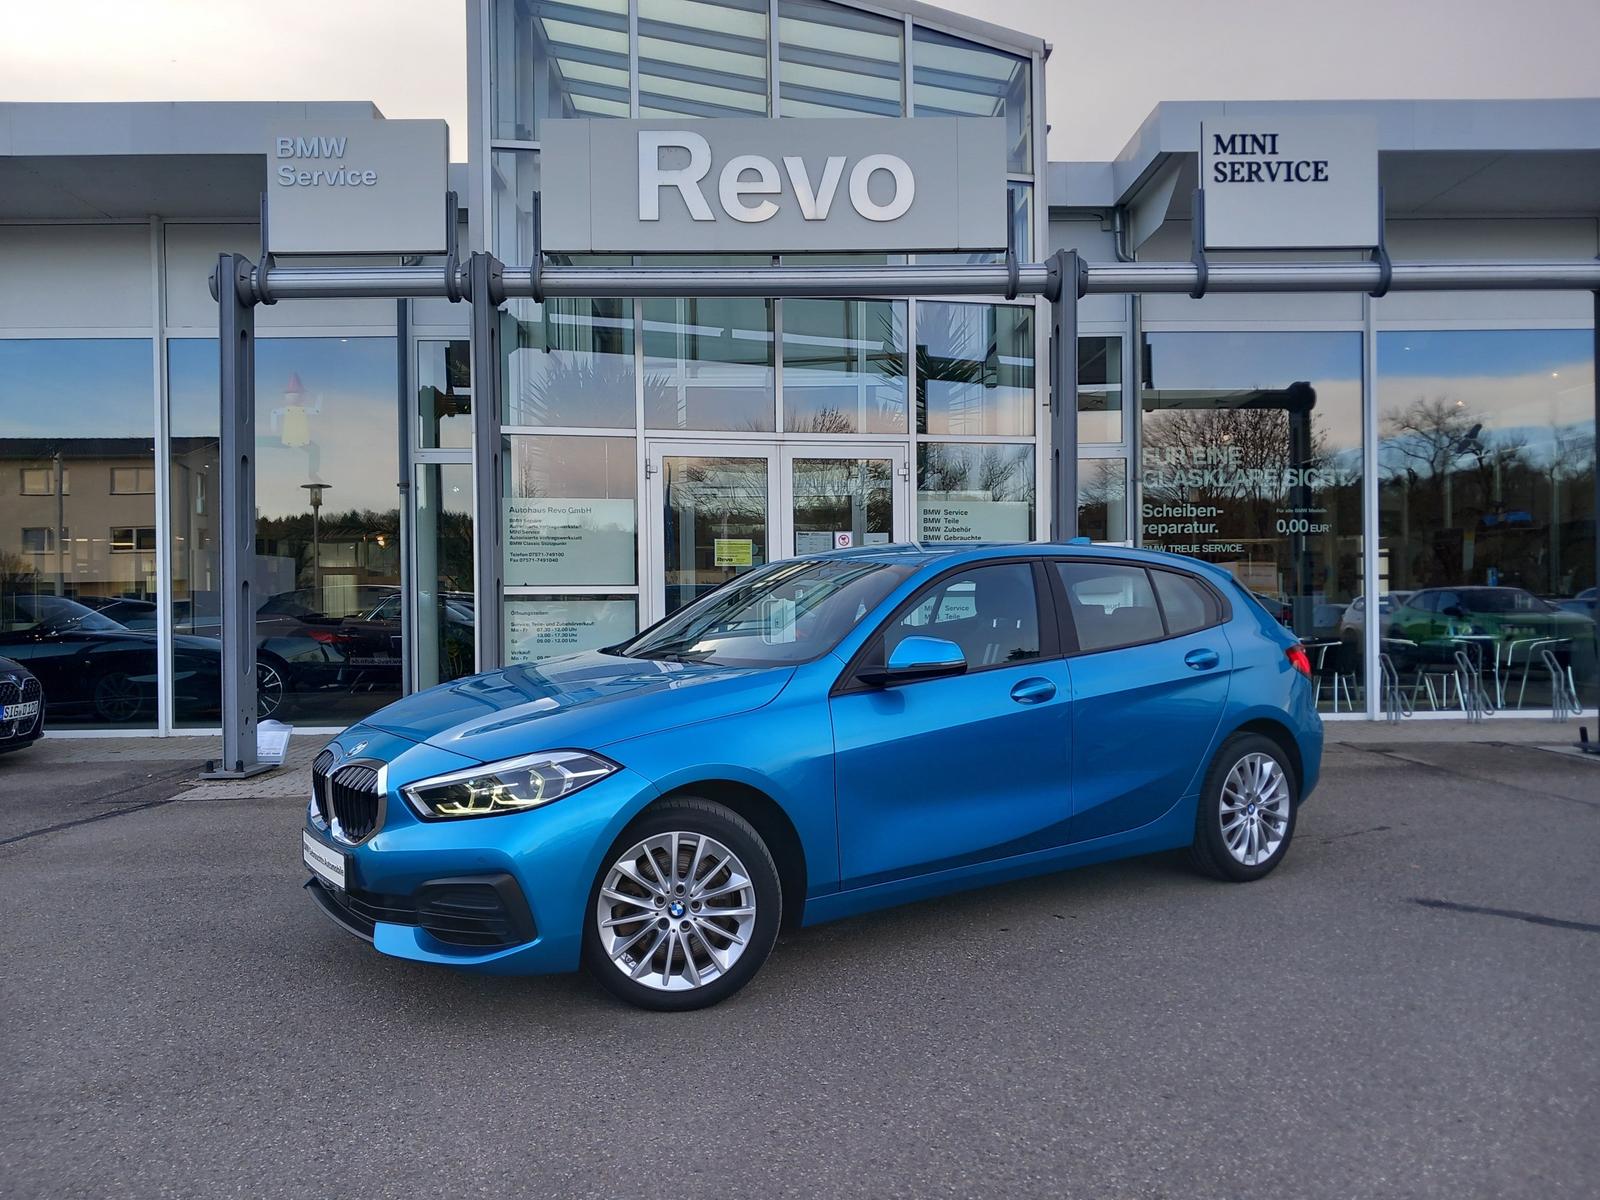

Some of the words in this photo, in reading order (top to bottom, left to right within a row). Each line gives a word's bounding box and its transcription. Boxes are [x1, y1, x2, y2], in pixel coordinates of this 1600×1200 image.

[276, 137, 347, 158] BMW
[1213, 134, 1279, 155] MINI
[277, 165, 377, 186] Service
[638, 130, 915, 222] Revo
[1213, 161, 1329, 183] SERVICE
[1192, 447, 1244, 465] EINE
[509, 506, 546, 514] Autohaus
[1142, 504, 1224, 518] Scheiben-
[1142, 520, 1219, 536] reparatur.
[1276, 519, 1309, 536] 0,00
[1169, 545, 1201, 553] TREUE
[1201, 544, 1245, 553] SERVICE.
[4, 706, 18, 718] SIG
